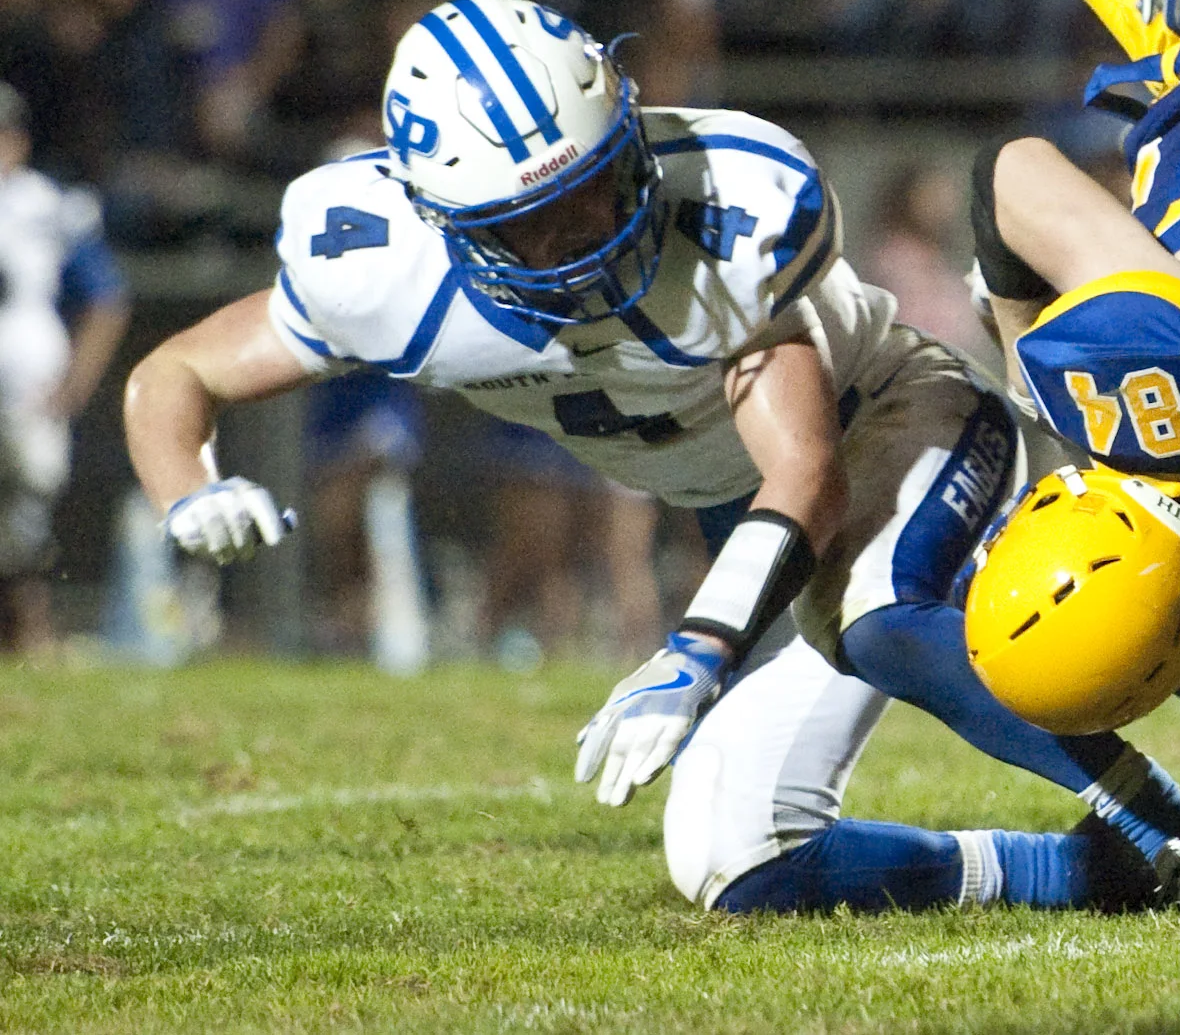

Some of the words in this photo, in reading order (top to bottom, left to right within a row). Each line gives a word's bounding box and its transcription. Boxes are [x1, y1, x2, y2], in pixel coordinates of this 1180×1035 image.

[520, 144, 579, 186] Riddell
[310, 205, 390, 260] 4
[674, 198, 760, 263] 4
